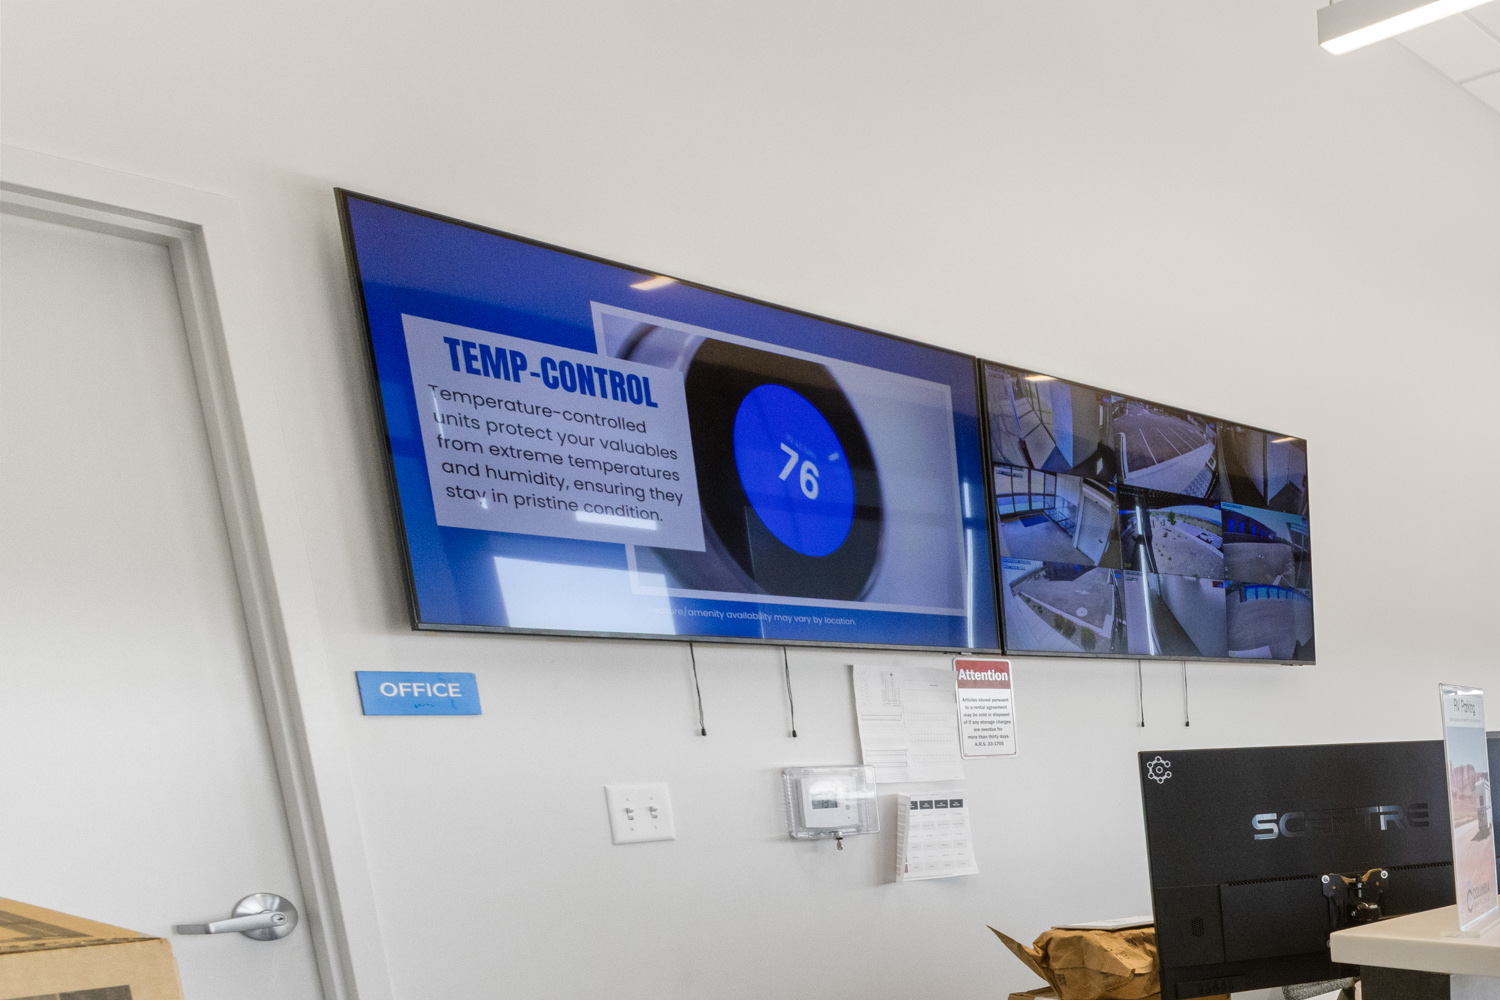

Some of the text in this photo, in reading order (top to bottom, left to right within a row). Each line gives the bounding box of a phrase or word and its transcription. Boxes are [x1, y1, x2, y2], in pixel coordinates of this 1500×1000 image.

[443, 336, 659, 408] TEMP-CONTROL
[428, 384, 646, 434] Temperature-controlled
[433, 411, 678, 460] units protect your valuables
[437, 434, 680, 482] from extreme temperatures
[779, 442, 819, 500] 76
[441, 460, 683, 507] and humidity, ensuring they
[445, 485, 664, 522] stay in pristine condition.
[651, 606, 857, 626] eature/amenity availability may vary by location.
[380, 682, 462, 697] OFFICE
[958, 668, 1008, 681] Attention
[1461, 699, 1476, 716] Parking
[1251, 802, 1429, 840] SCTRE
